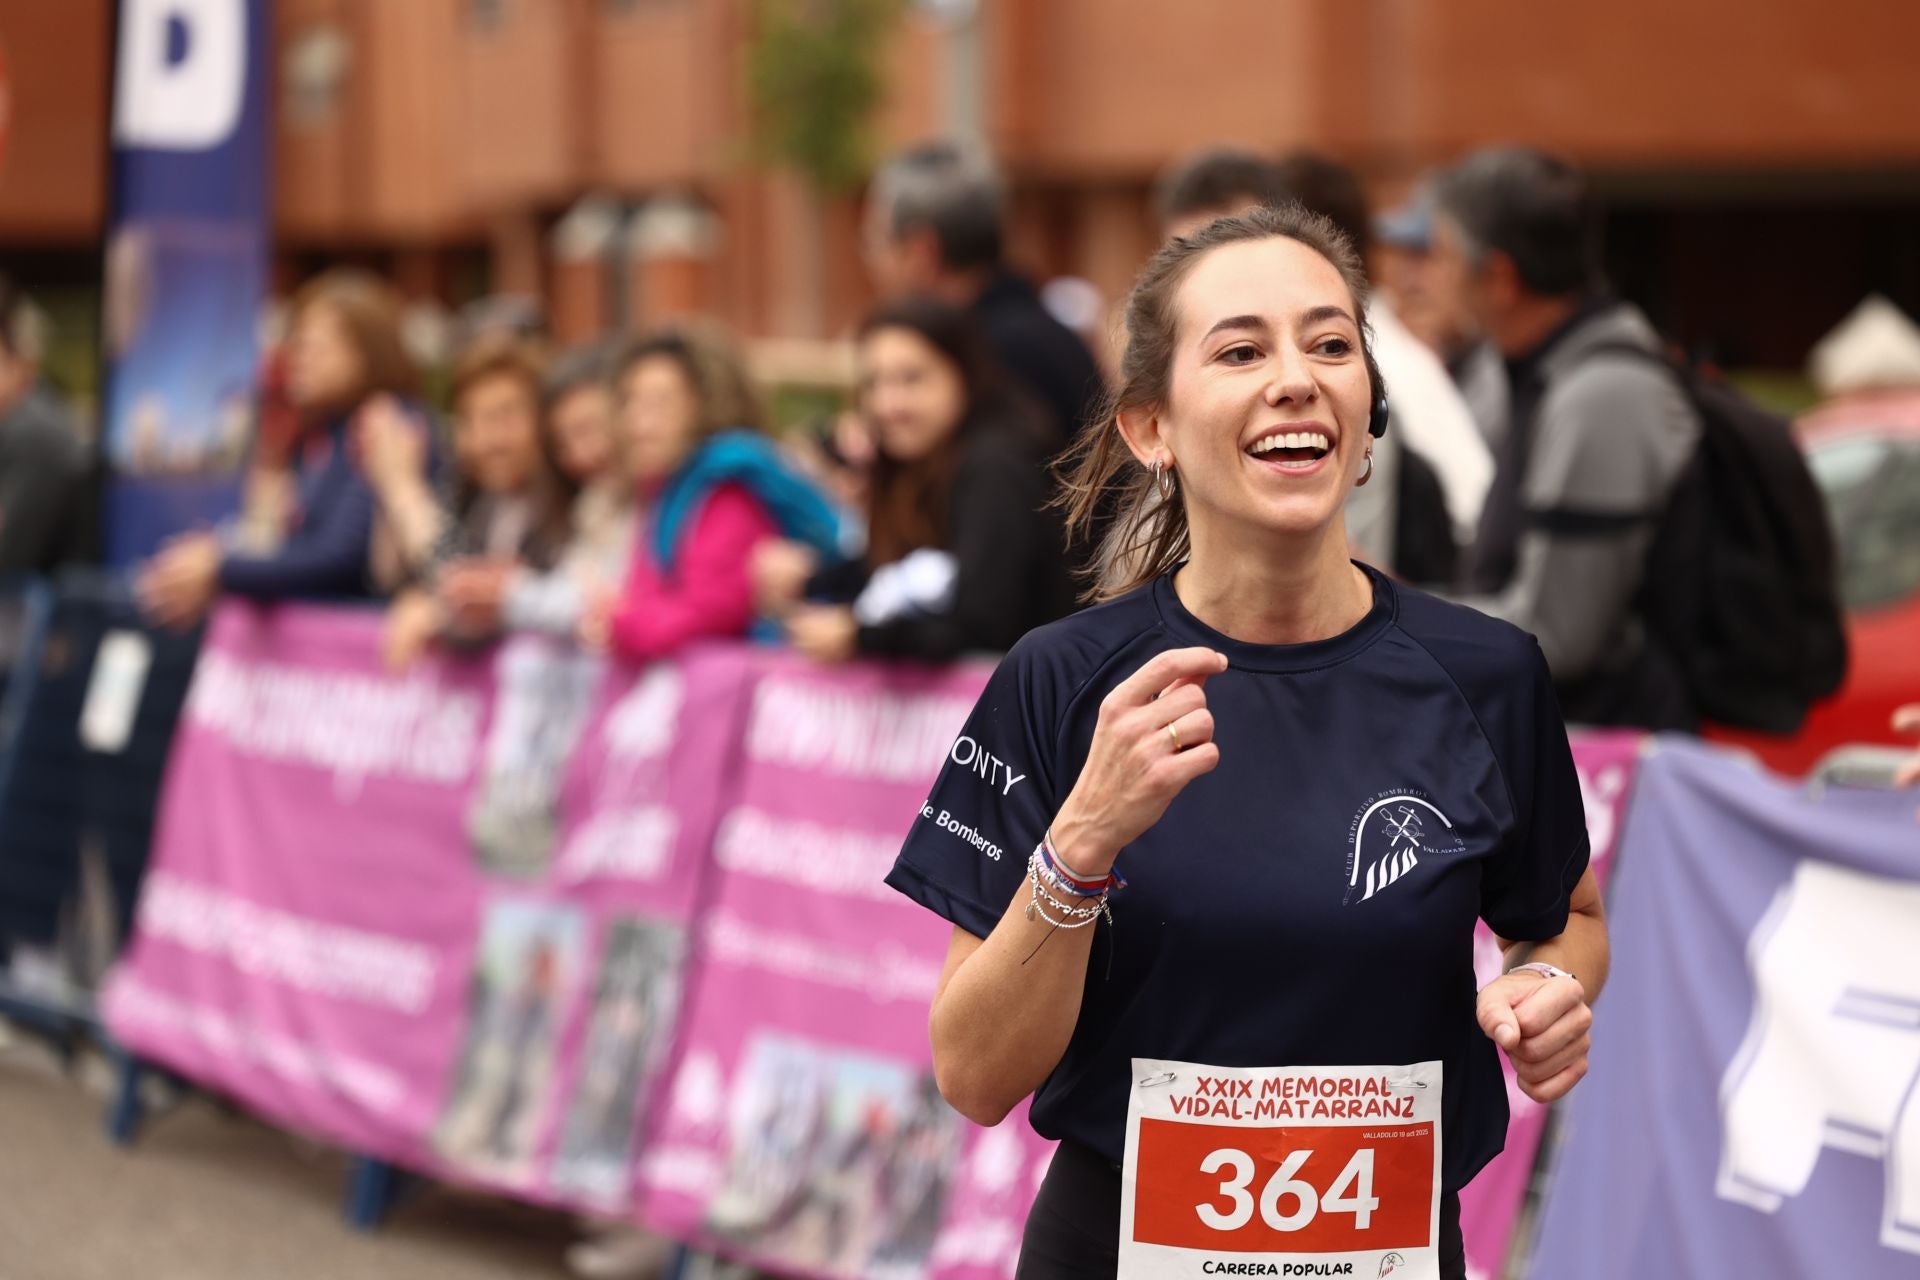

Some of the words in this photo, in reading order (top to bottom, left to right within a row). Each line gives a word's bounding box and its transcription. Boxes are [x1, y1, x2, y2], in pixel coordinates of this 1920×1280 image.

[935, 809, 1003, 861] Bomberos
[1348, 797, 1375, 844] DEPORTIVO
[1378, 788, 1428, 799] BOMBEROS
[1195, 1076, 1254, 1099] XXIX
[1261, 1076, 1392, 1099] MEMORIAL
[1169, 1095, 1415, 1120] VIDAL-MATARRANZ
[1194, 1148, 1380, 1232] 364
[1202, 1260, 1279, 1276] CARRERA
[1283, 1262, 1353, 1276] POPULAR
